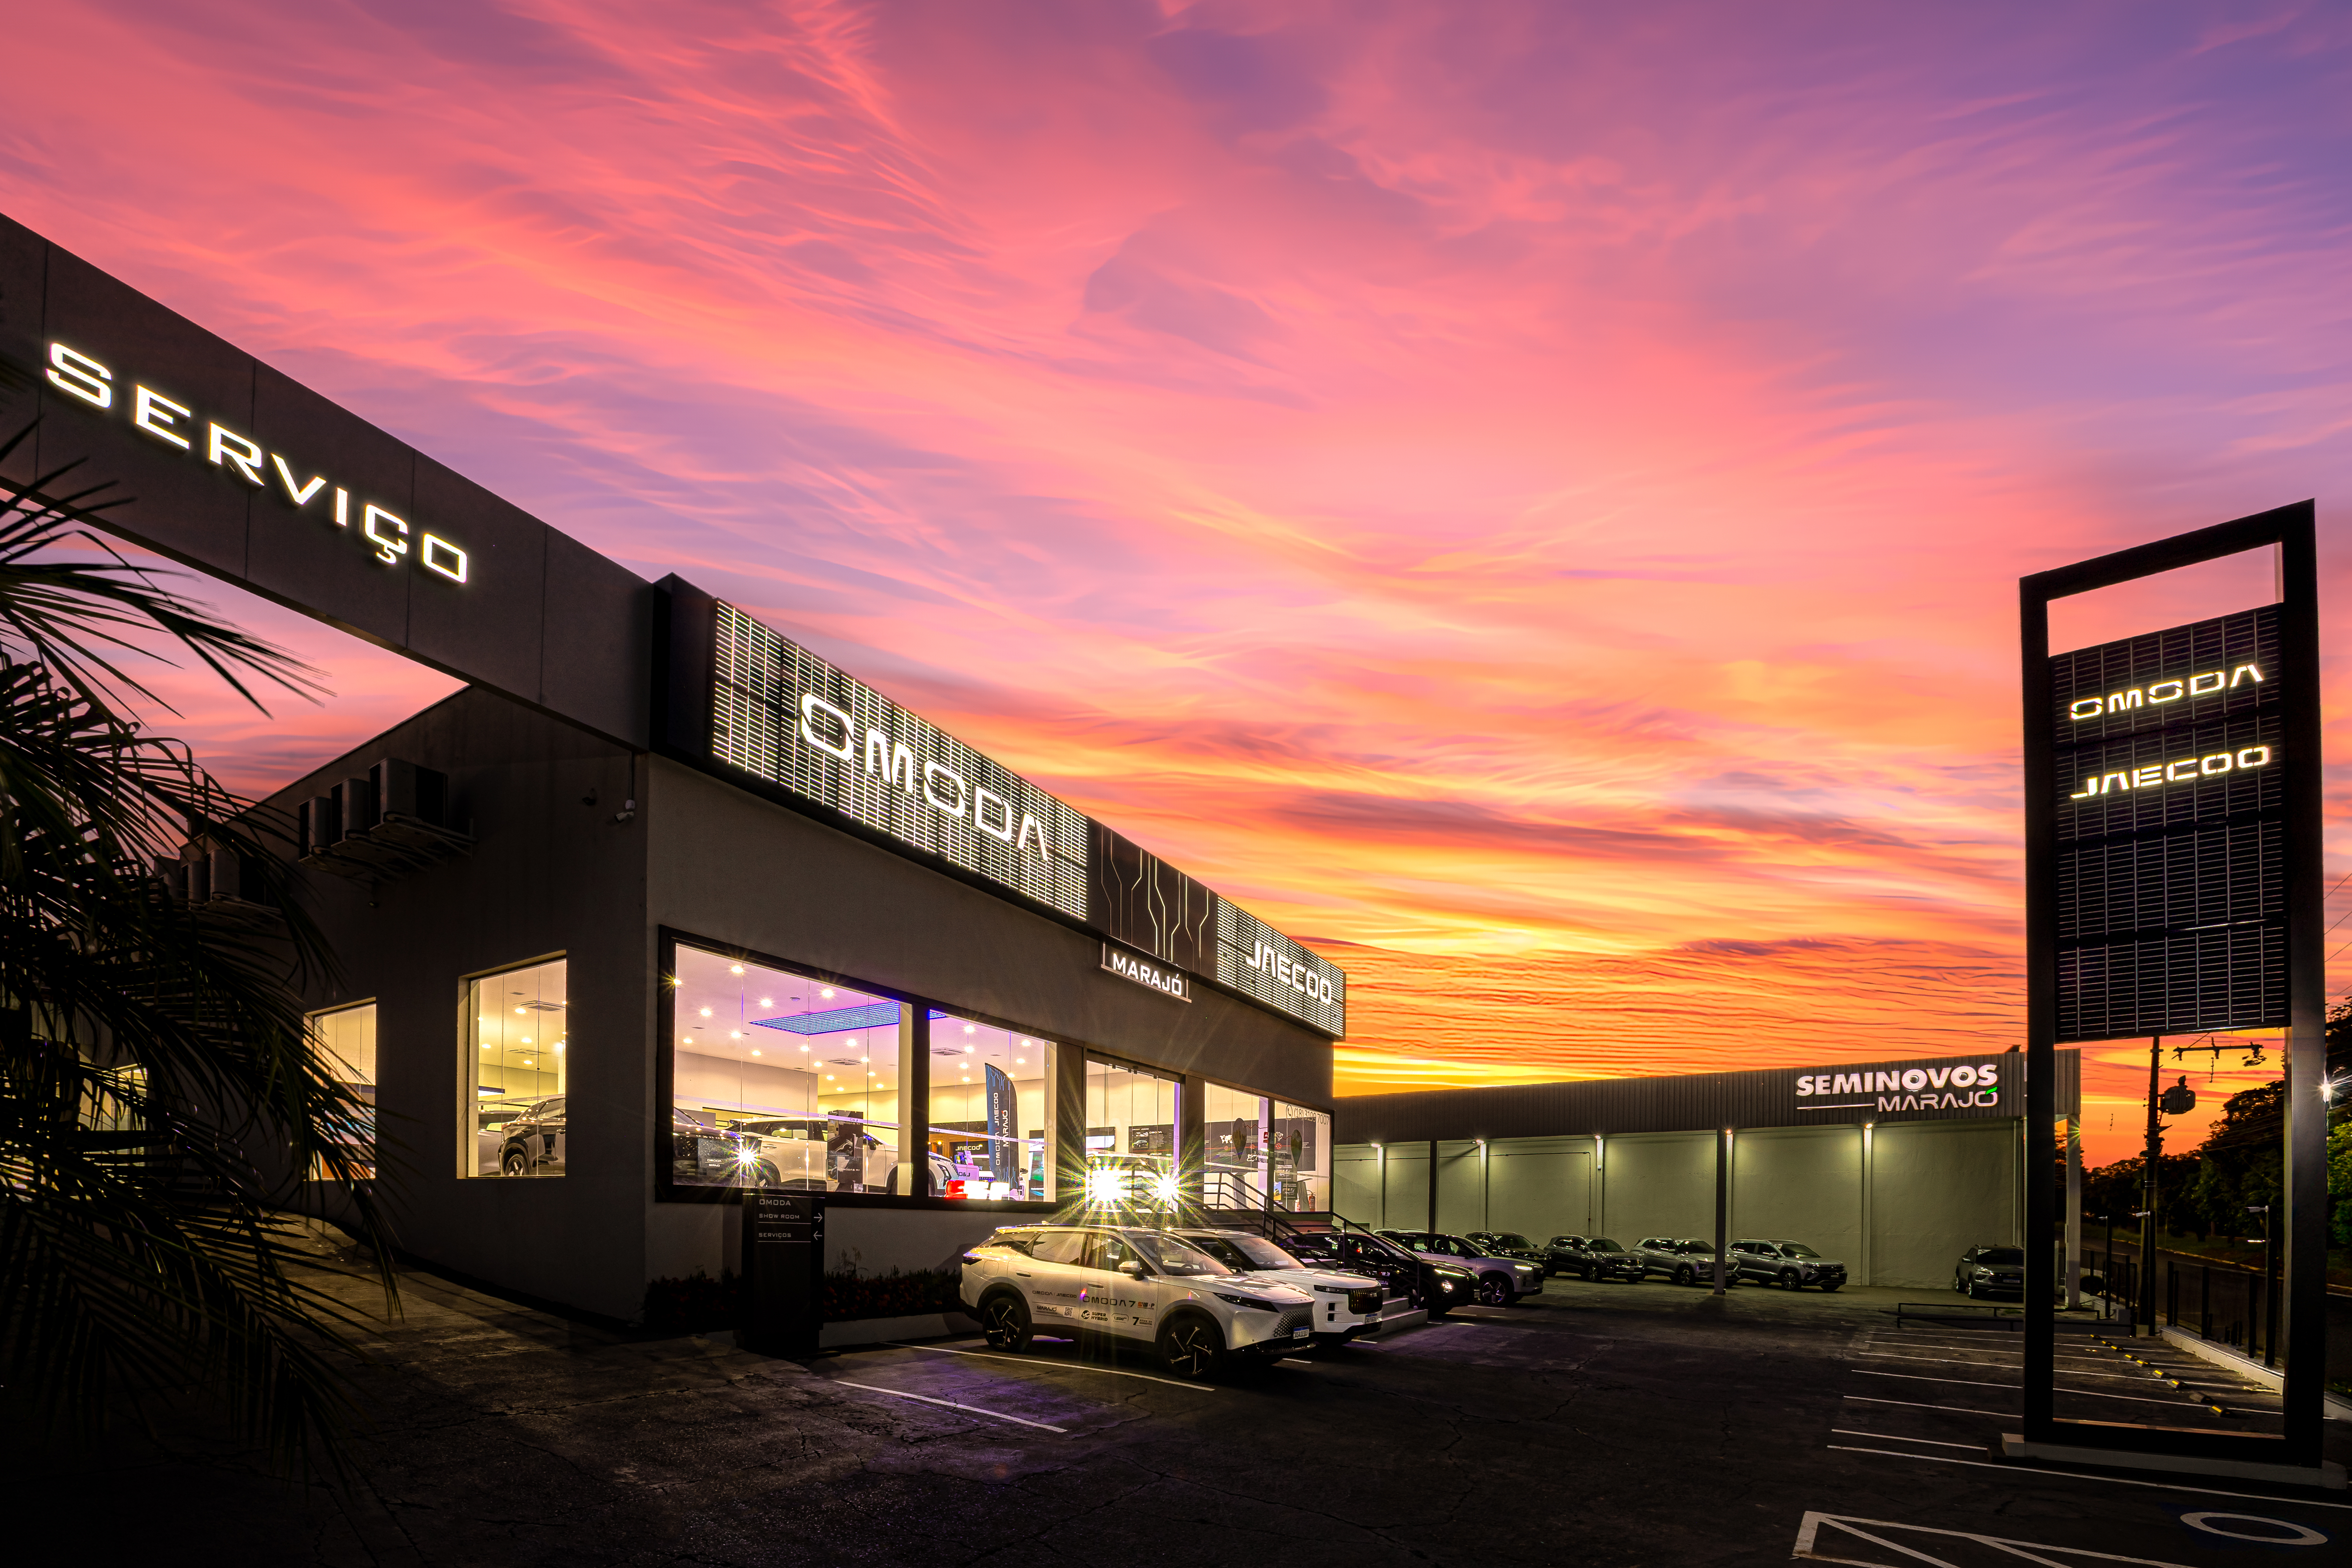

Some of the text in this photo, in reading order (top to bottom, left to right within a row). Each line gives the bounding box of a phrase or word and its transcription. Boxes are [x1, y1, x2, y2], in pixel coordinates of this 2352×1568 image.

[47, 342, 468, 584] SERVIÇO
[2070, 664, 2264, 720] OMODA
[800, 692, 1049, 863] OMODA
[2070, 746, 2271, 799] JAECOO
[1112, 953, 1183, 996] MARAJÓ
[1244, 940, 1332, 1005] JAECOO
[1796, 1064, 1998, 1097] SEMINOVOS
[1878, 1086, 1998, 1112] MARAJÓ
[1317, 1114, 1329, 1125] 7007
[1083, 1296, 1126, 1307] OMODA
[1132, 1316, 1139, 1325] 7
